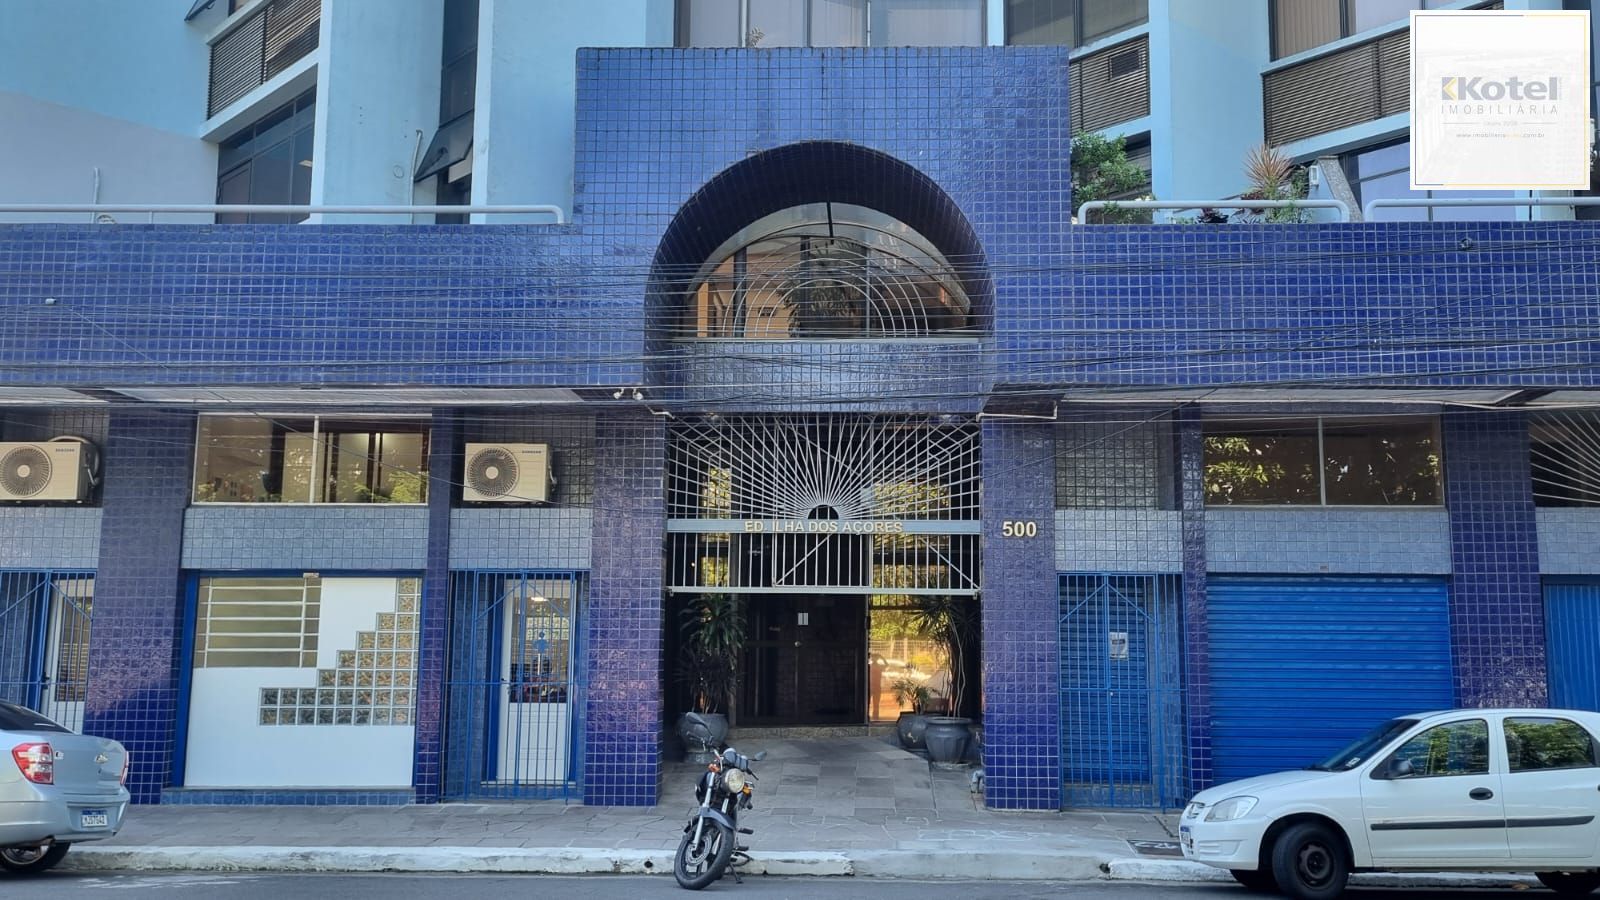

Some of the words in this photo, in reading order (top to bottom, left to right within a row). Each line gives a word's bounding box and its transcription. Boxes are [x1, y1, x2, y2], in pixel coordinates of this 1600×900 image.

[744, 520, 767, 533] ED.
[772, 520, 804, 533] ILHA
[808, 520, 838, 533] DOS
[842, 521, 903, 535] AÇORES
[1002, 520, 1037, 537] 500
